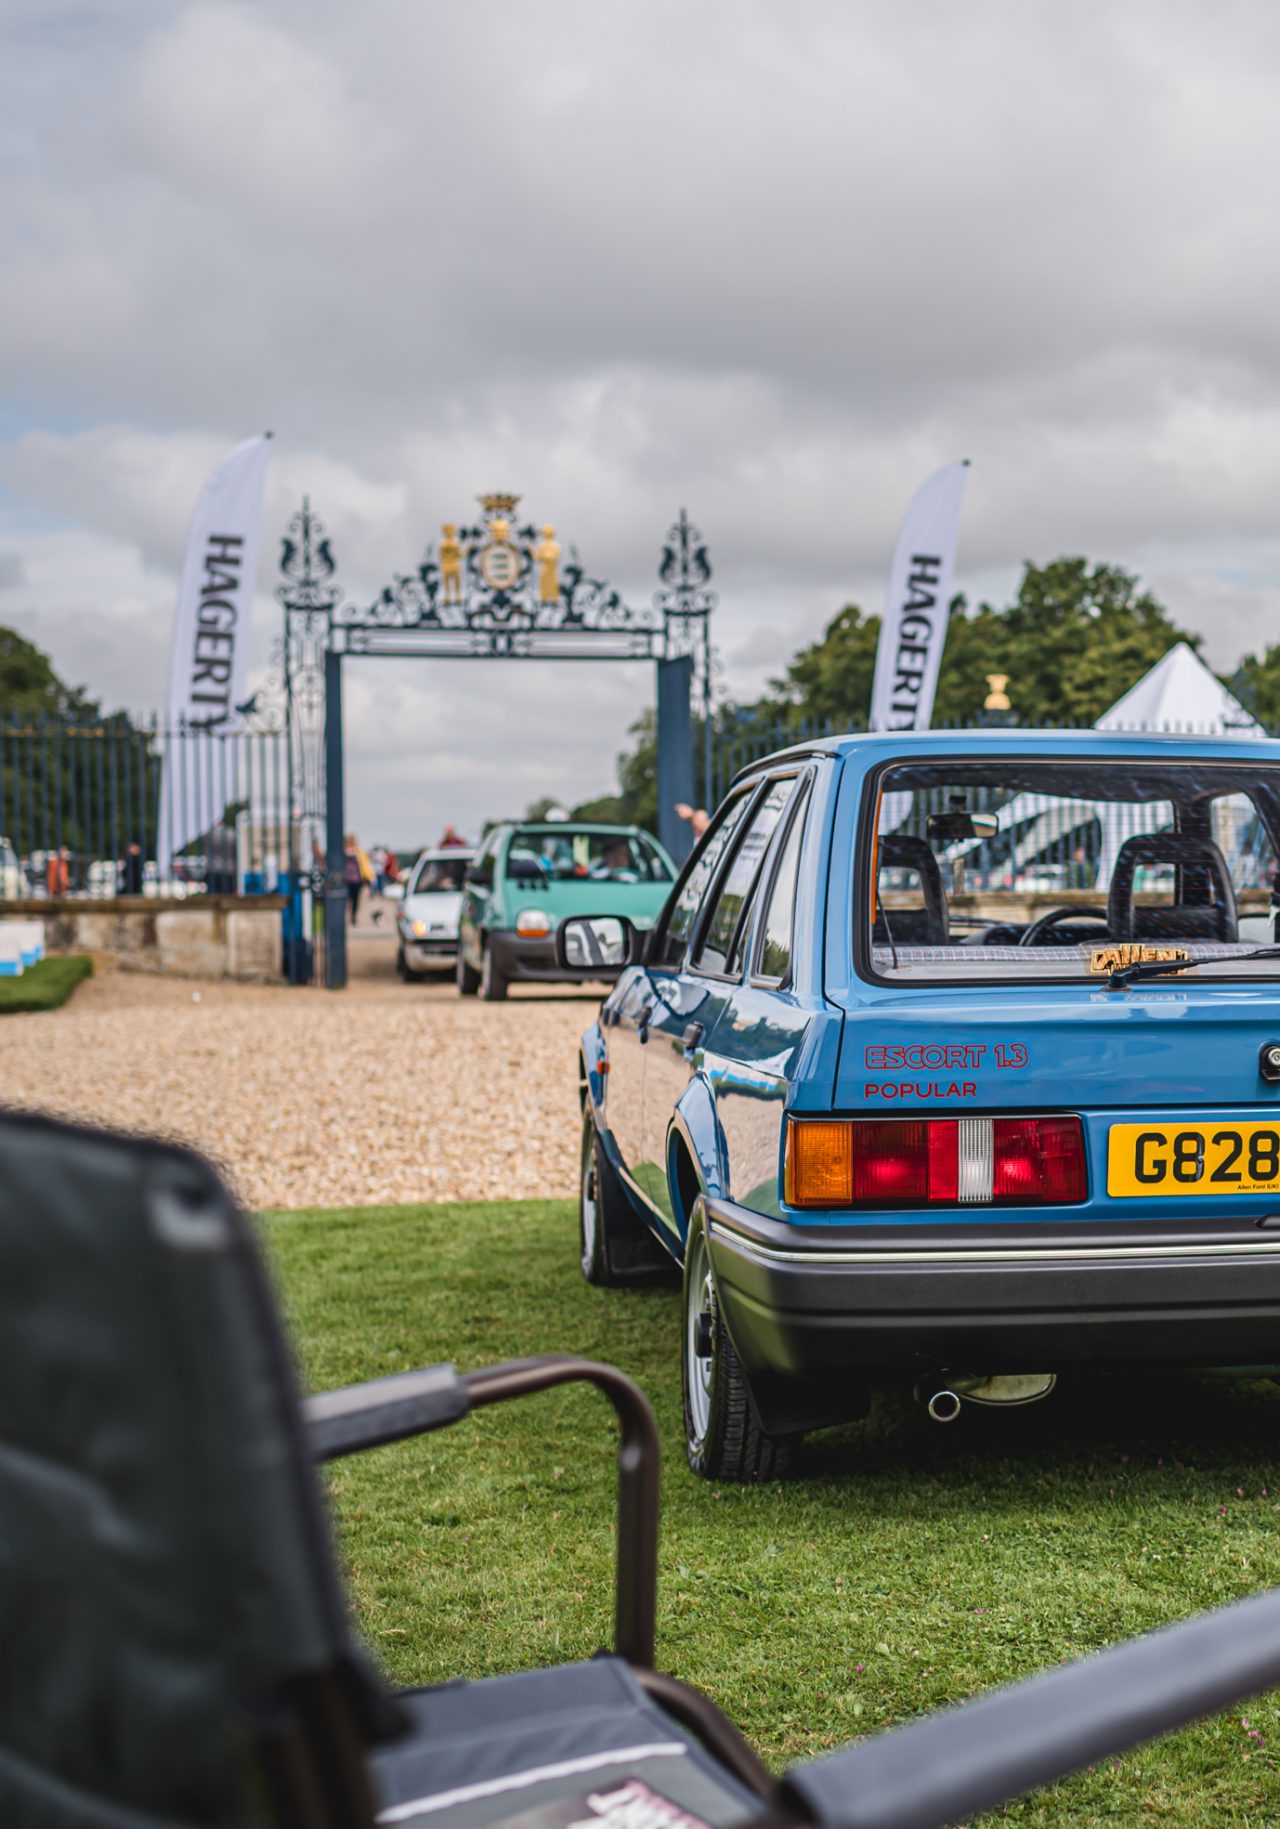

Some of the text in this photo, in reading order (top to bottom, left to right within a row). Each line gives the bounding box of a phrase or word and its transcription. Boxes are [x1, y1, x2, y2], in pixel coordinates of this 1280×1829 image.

[865, 1043, 1029, 1070] ESCORT 1.3
[864, 1082, 977, 1099] POPULAR
[1134, 1130, 1280, 1184] G828
